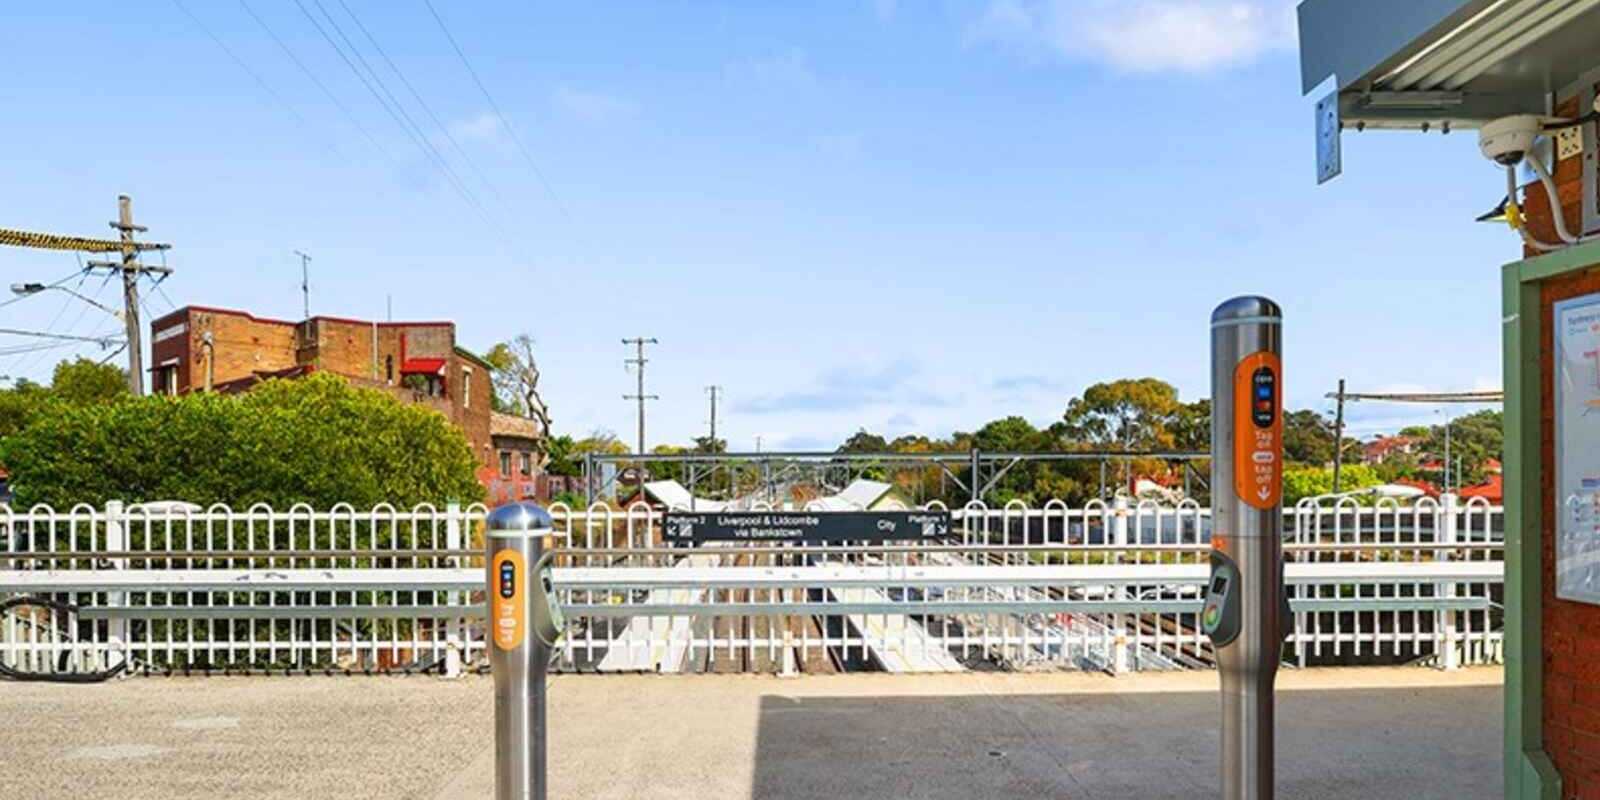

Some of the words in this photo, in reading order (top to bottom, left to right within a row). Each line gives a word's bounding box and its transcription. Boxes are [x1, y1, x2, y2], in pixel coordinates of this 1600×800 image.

[667, 516, 699, 524] Platform
[700, 516, 706, 524] 2
[717, 516, 761, 527] Liverpool
[764, 516, 771, 525] &
[773, 516, 819, 525] Lidcombe
[908, 515, 940, 523] Platform
[876, 519, 896, 532] City
[735, 528, 749, 537] via
[751, 528, 803, 537] Bankstown
